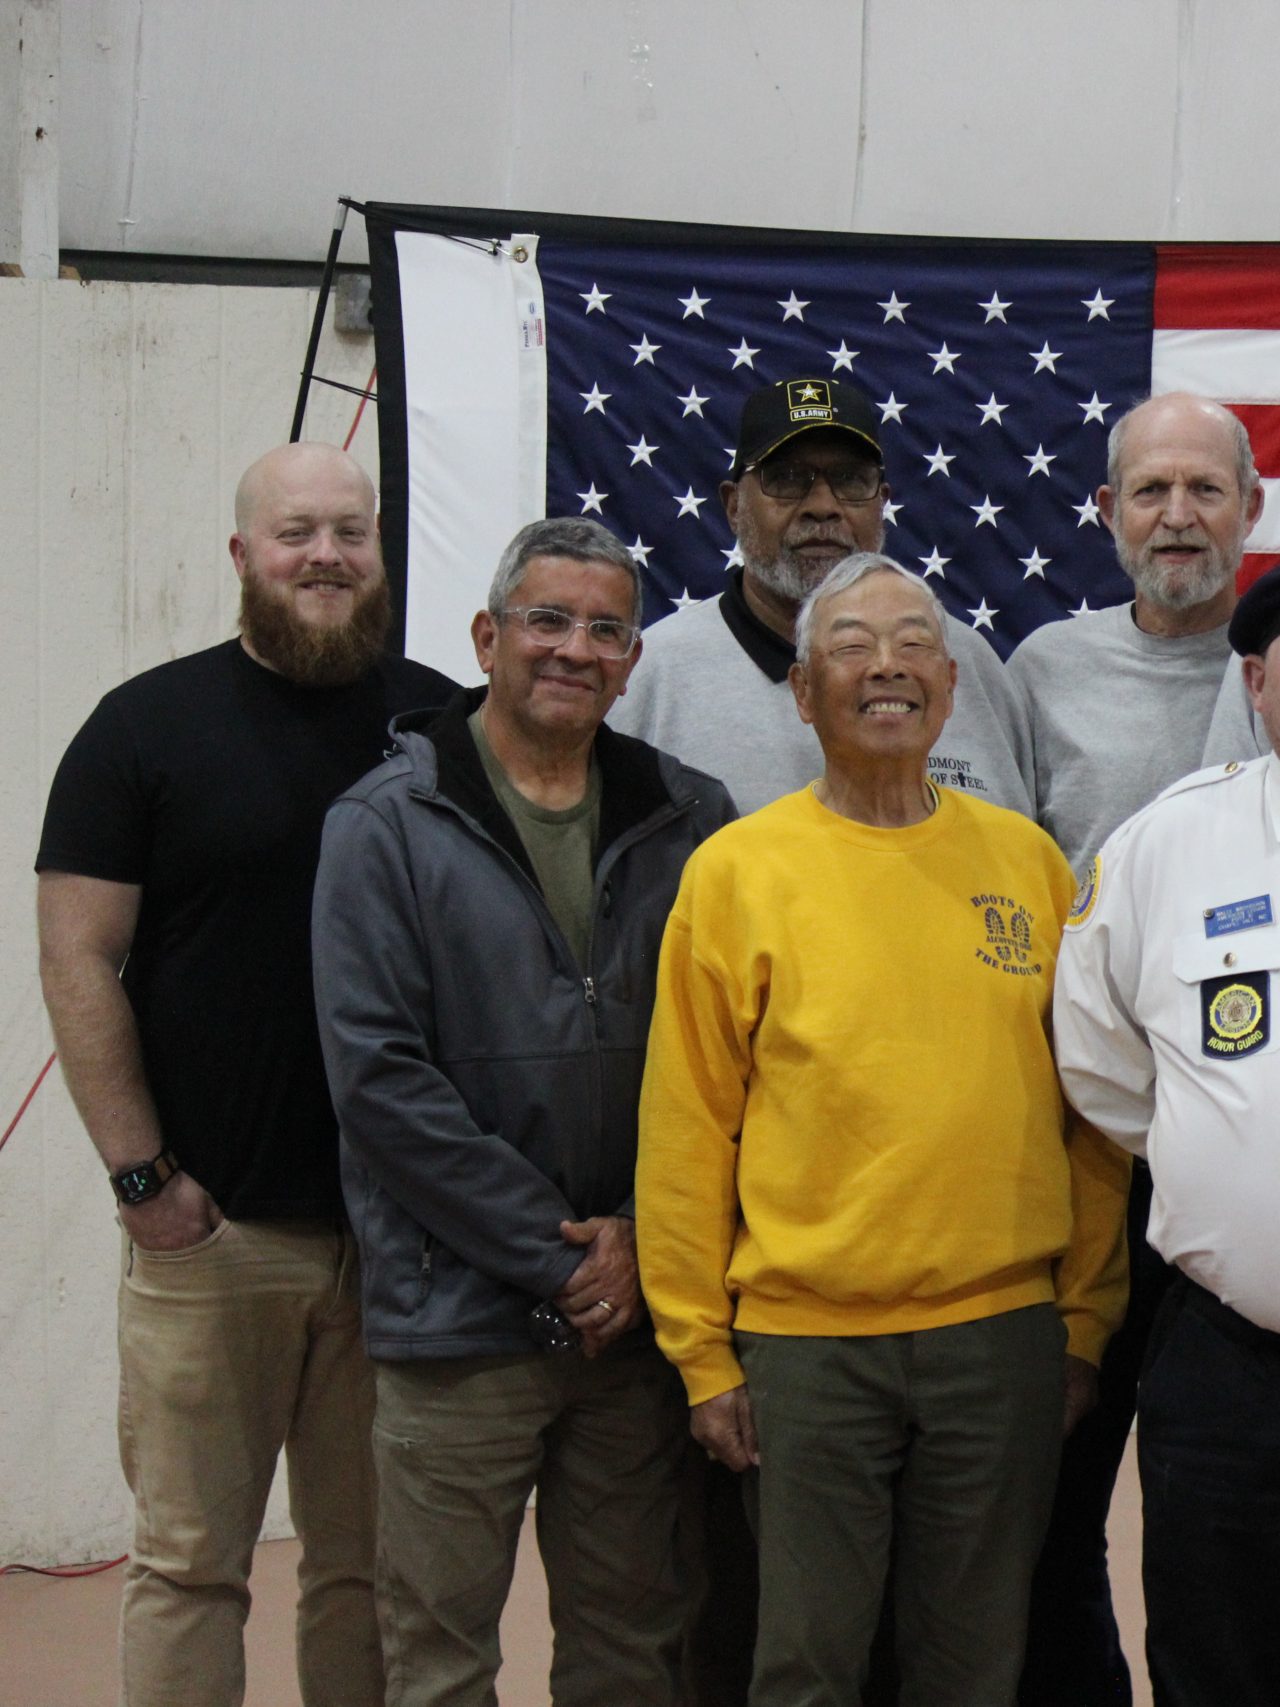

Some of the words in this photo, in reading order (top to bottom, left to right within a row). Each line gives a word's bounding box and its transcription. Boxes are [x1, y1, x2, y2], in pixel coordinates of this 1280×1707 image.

[928, 757, 971, 773] DMONT
[931, 773, 947, 785] OF
[970, 893, 1015, 909] BOOTS
[975, 947, 999, 969] THE
[1206, 1036, 1235, 1053] HONOR
[1236, 1030, 1264, 1051] GUARD
